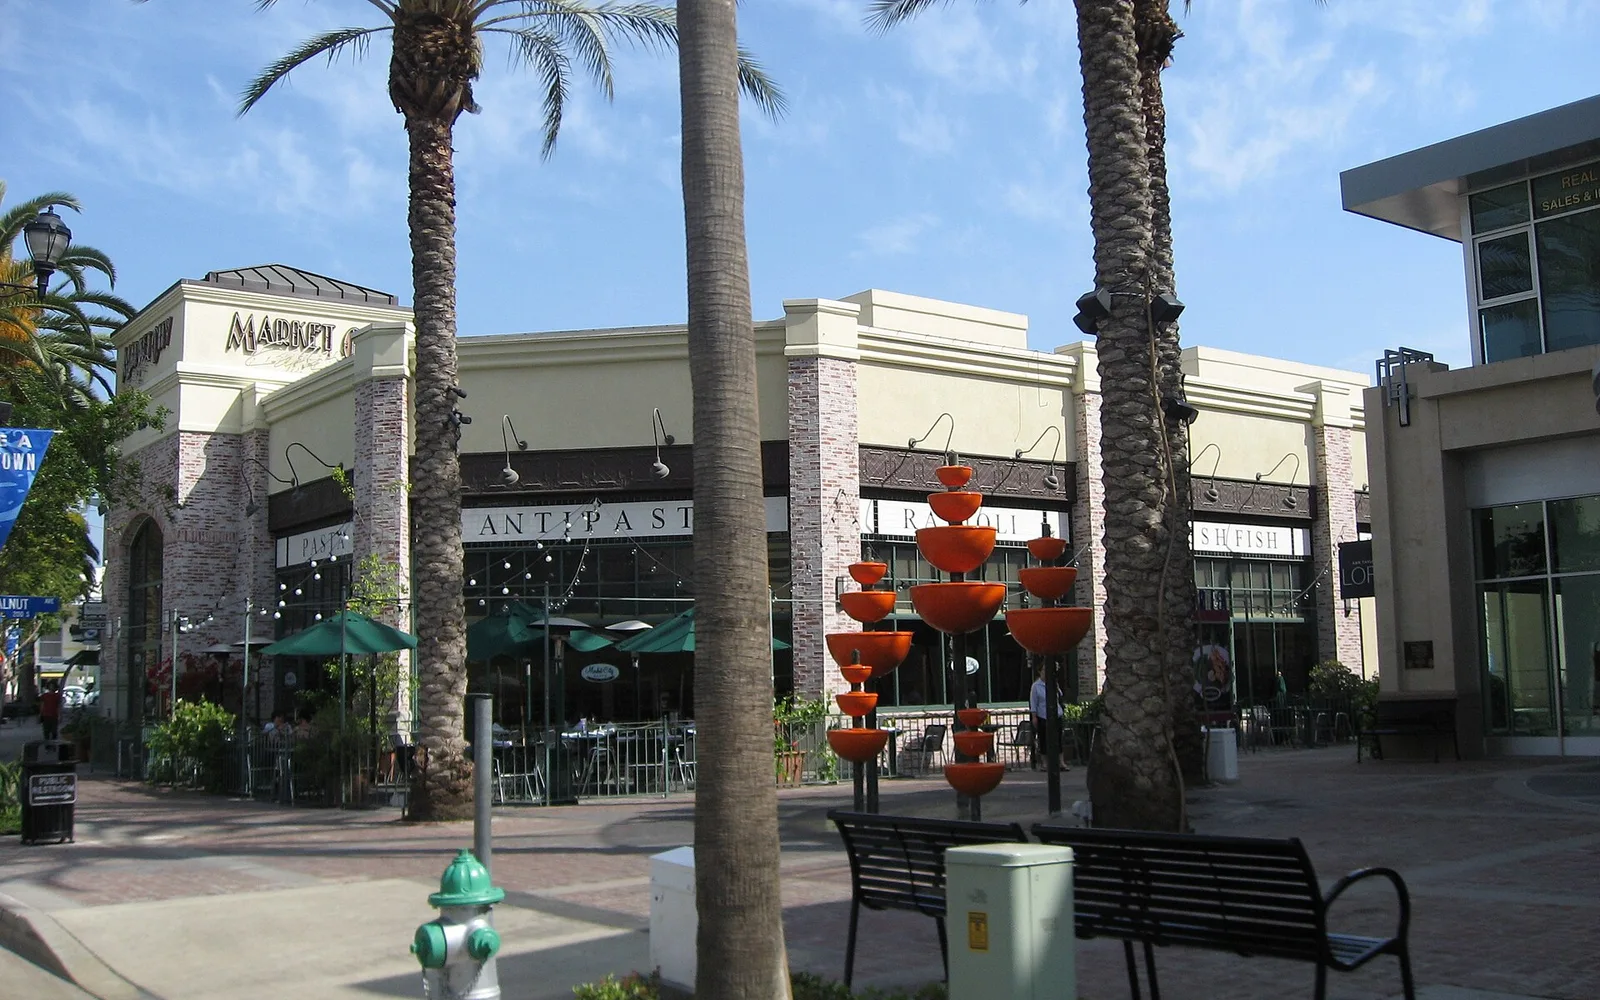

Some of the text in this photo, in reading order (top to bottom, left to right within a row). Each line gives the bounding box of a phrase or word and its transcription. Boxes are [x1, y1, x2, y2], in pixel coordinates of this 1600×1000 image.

[1562, 170, 1598, 188] REAL
[1542, 193, 1581, 211] SALES
[1583, 191, 1592, 202] &
[226, 312, 336, 353] MARKET
[0, 452, 36, 471] OWN
[479, 507, 693, 536] ANTIPAST
[904, 508, 1016, 535] RAOLI
[1342, 565, 1374, 586] LOF
